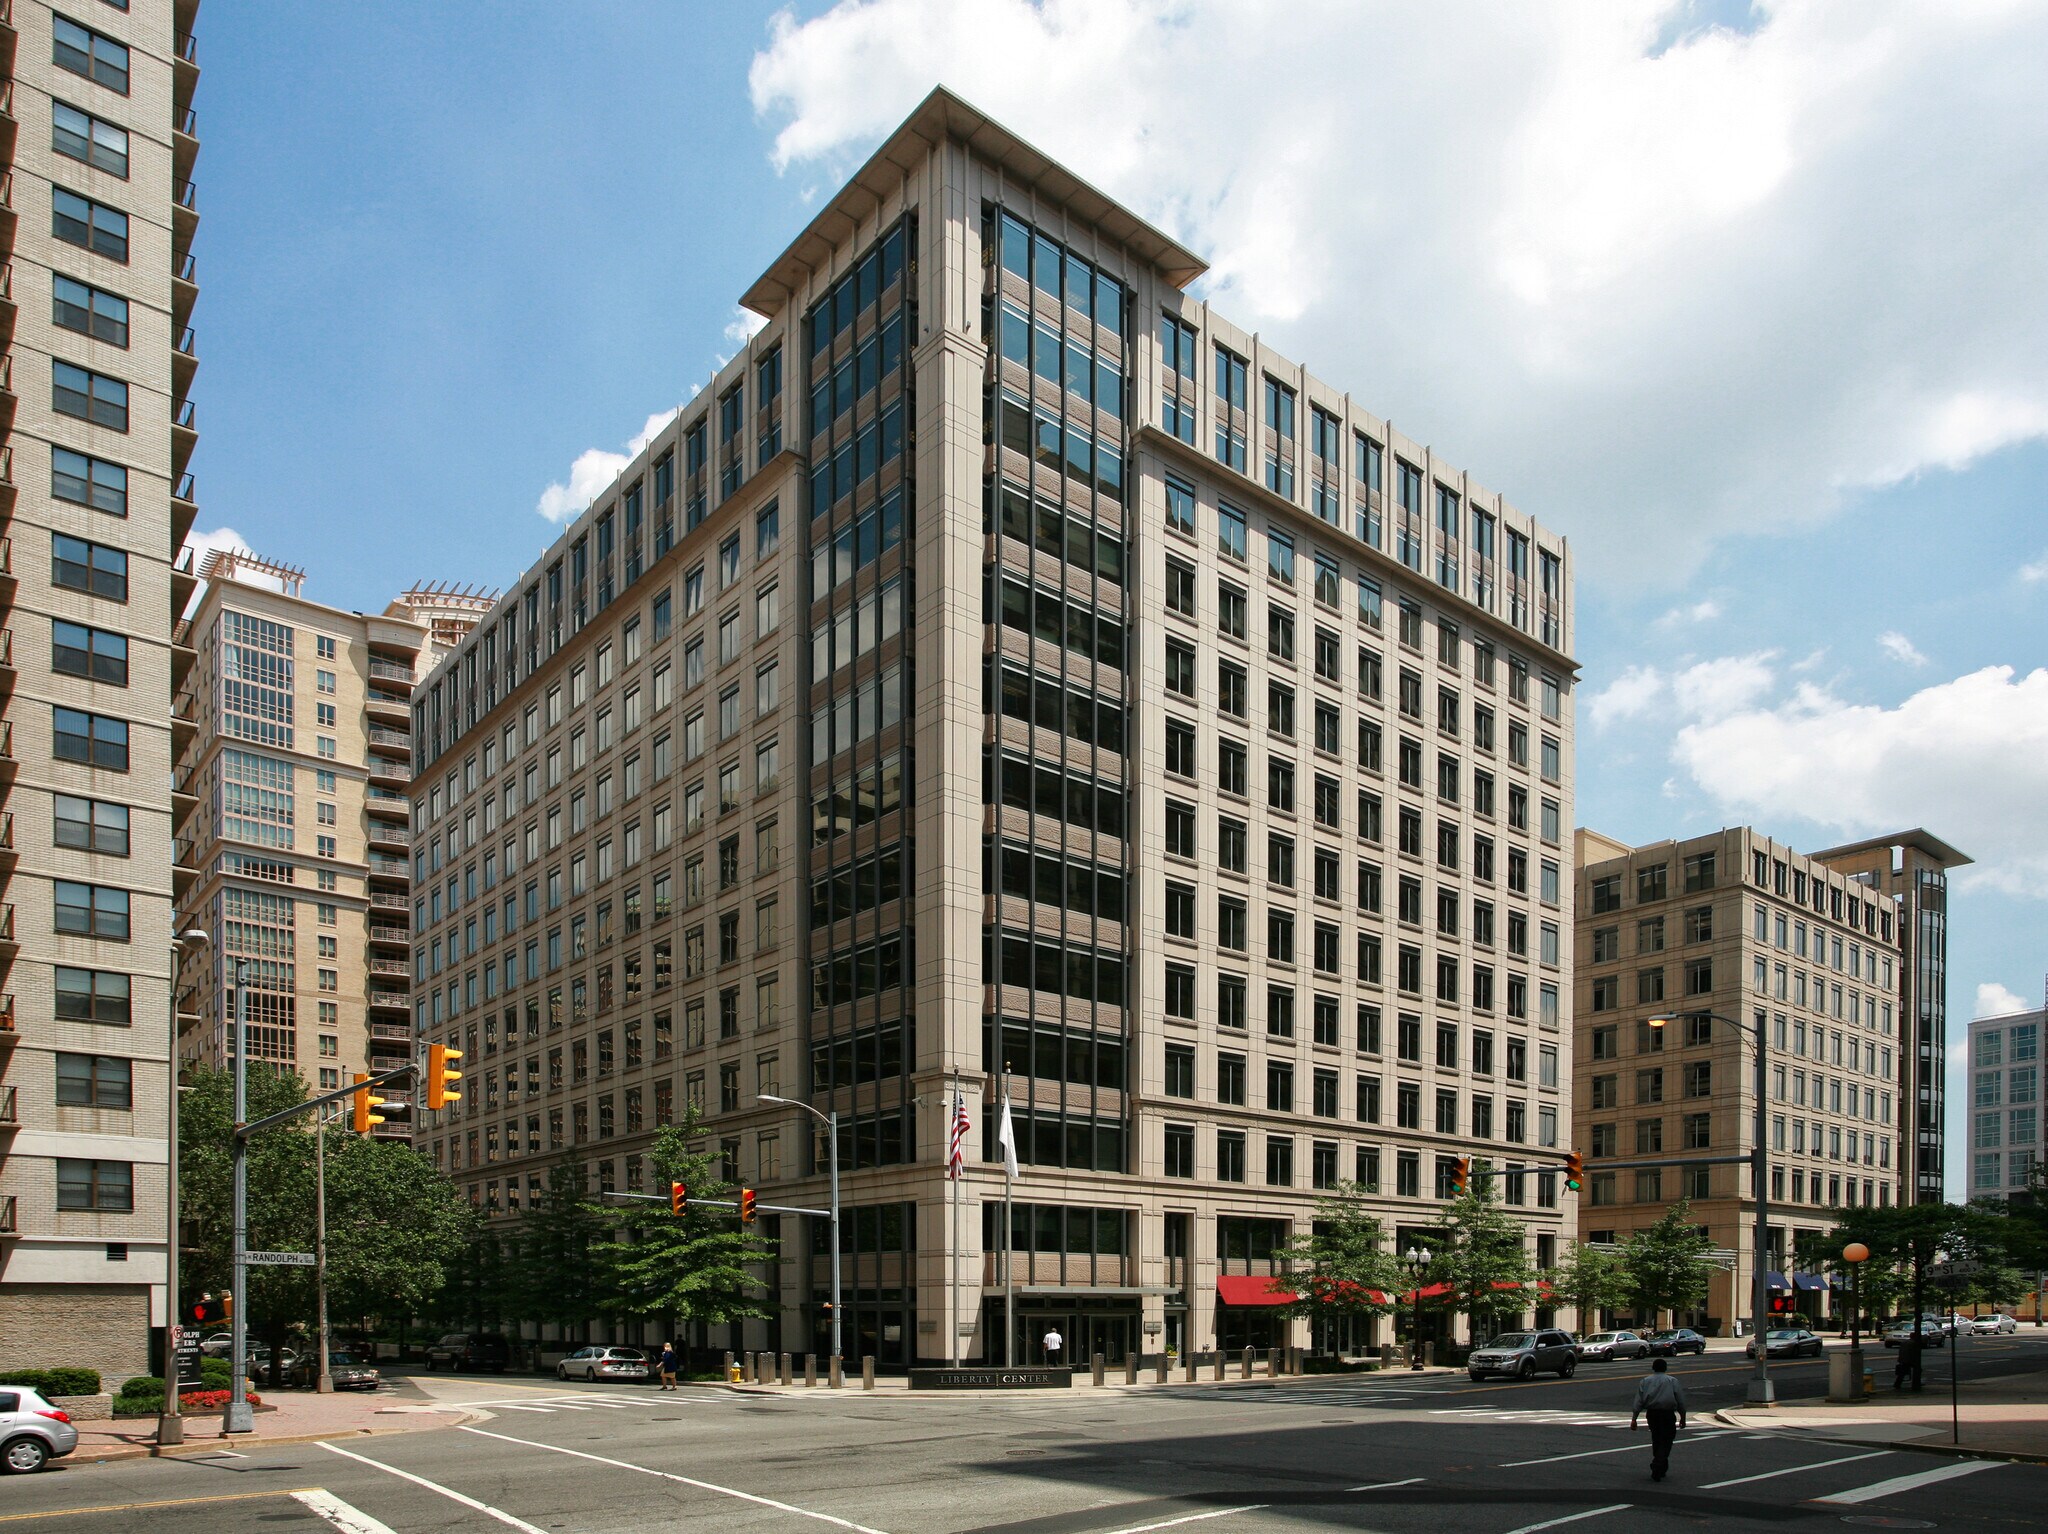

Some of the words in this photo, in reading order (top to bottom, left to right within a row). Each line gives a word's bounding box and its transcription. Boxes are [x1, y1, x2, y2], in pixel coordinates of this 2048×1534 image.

[253, 1253, 298, 1263] RANDOLPH
[1942, 1264, 1955, 1275] ST
[940, 1375, 991, 1384] LIBERTY
[1003, 1374, 1049, 1383] CENTER
